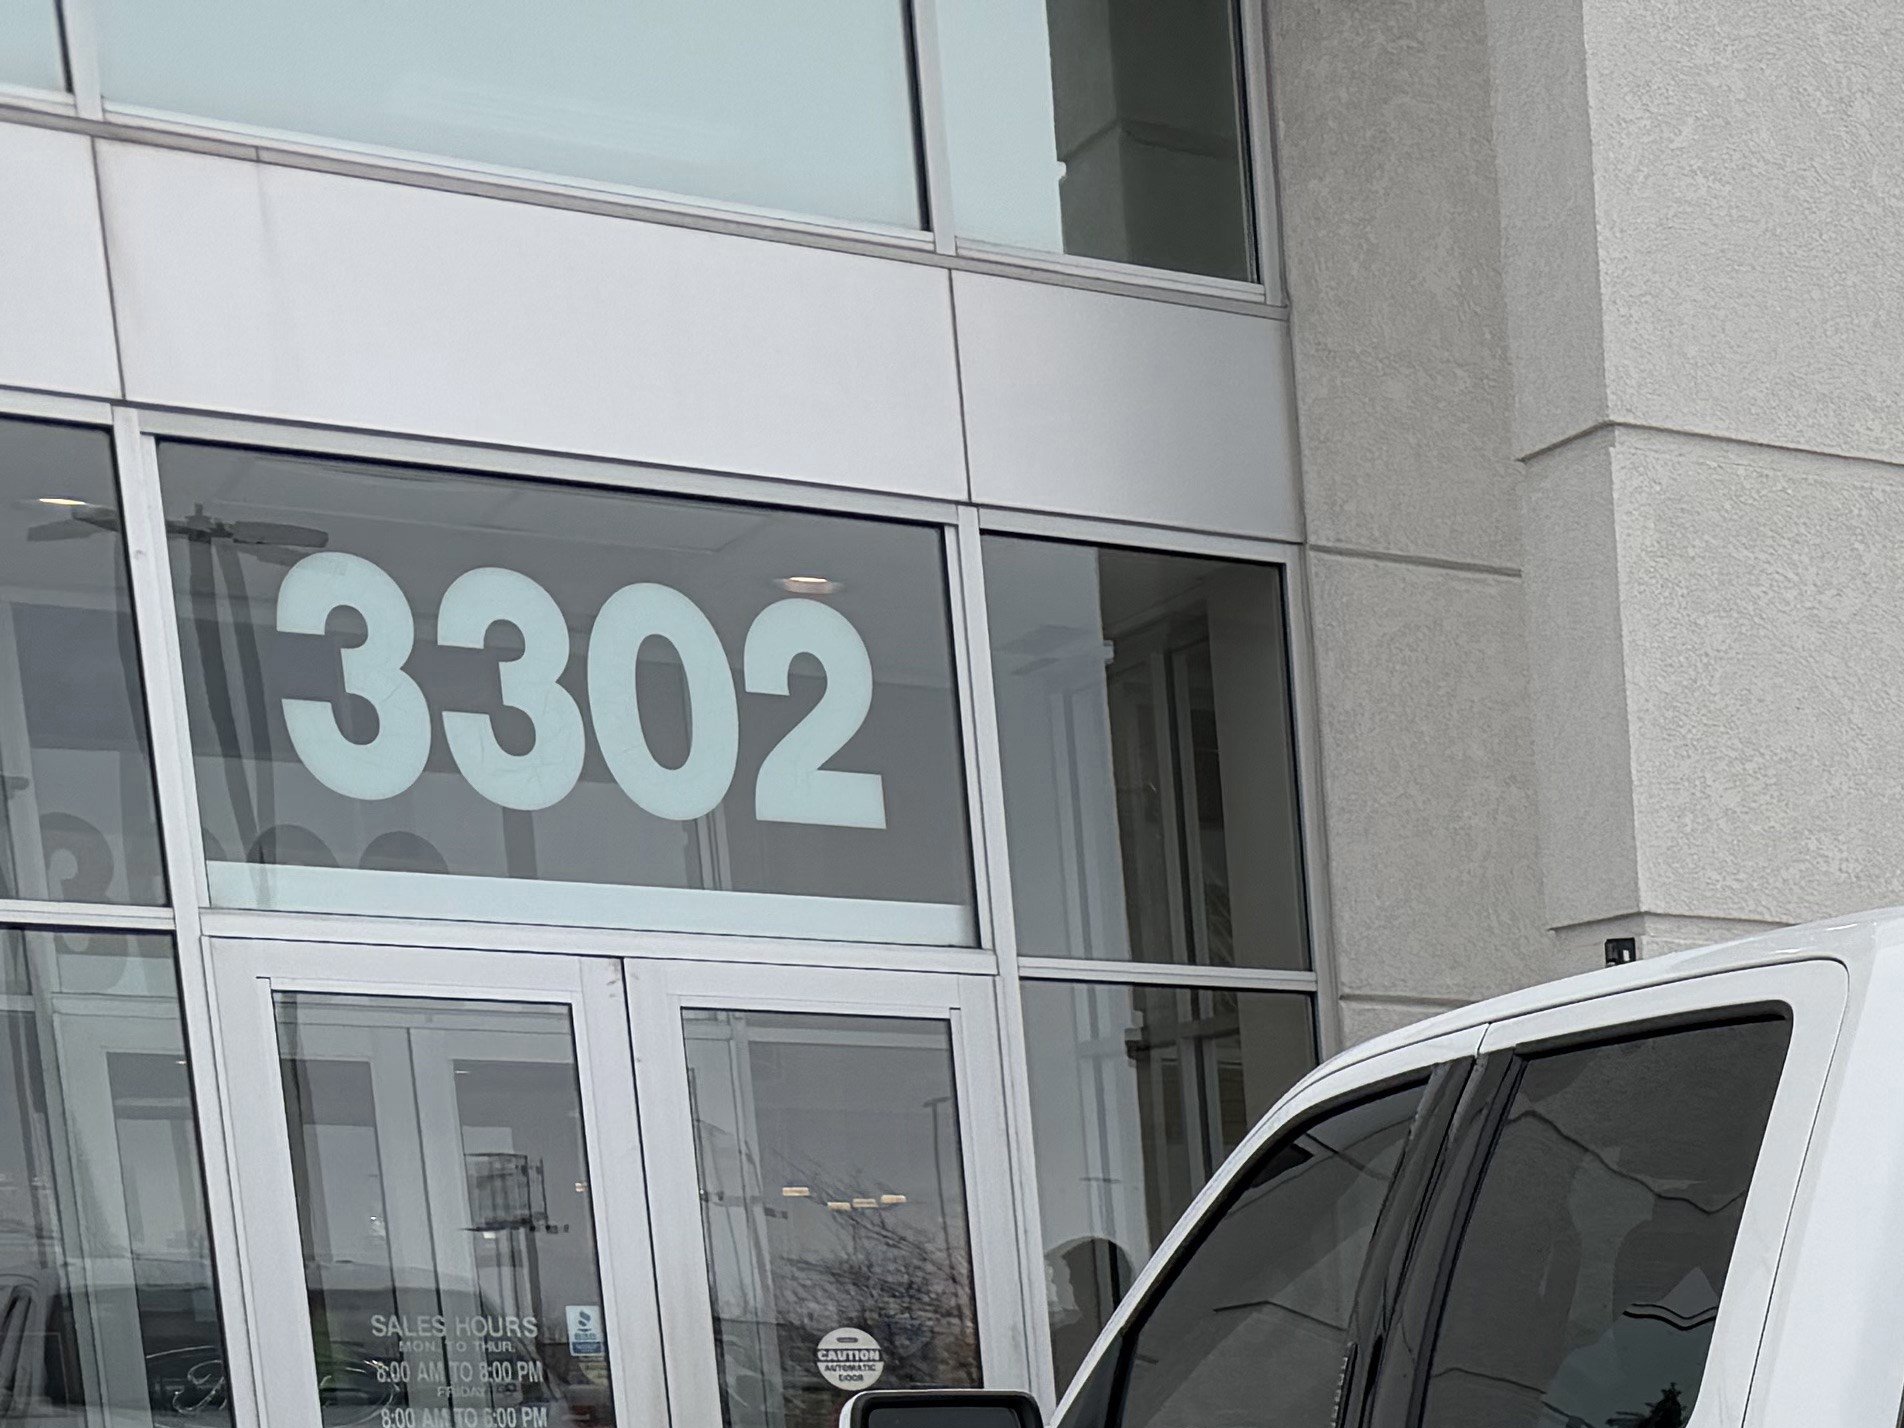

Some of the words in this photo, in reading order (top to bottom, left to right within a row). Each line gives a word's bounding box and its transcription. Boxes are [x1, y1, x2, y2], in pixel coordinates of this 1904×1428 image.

[276, 551, 887, 829] 3302
[370, 1314, 447, 1337] SALES
[455, 1315, 539, 1338] HOURS
[817, 1349, 880, 1361] CAUTION
[376, 1361, 411, 1383] 8:00
[417, 1361, 447, 1382] AM
[450, 1361, 473, 1382] TO
[479, 1360, 512, 1383] 8:00
[517, 1360, 545, 1382] PM
[824, 1363, 876, 1372] AUTOMATIC
[838, 1374, 864, 1382] DOOR
[436, 1385, 487, 1398] FRIDAY
[422, 1407, 452, 1428] AM
[453, 1407, 477, 1428] TO
[484, 1407, 517, 1428] 6:00
[521, 1406, 548, 1428] PM
